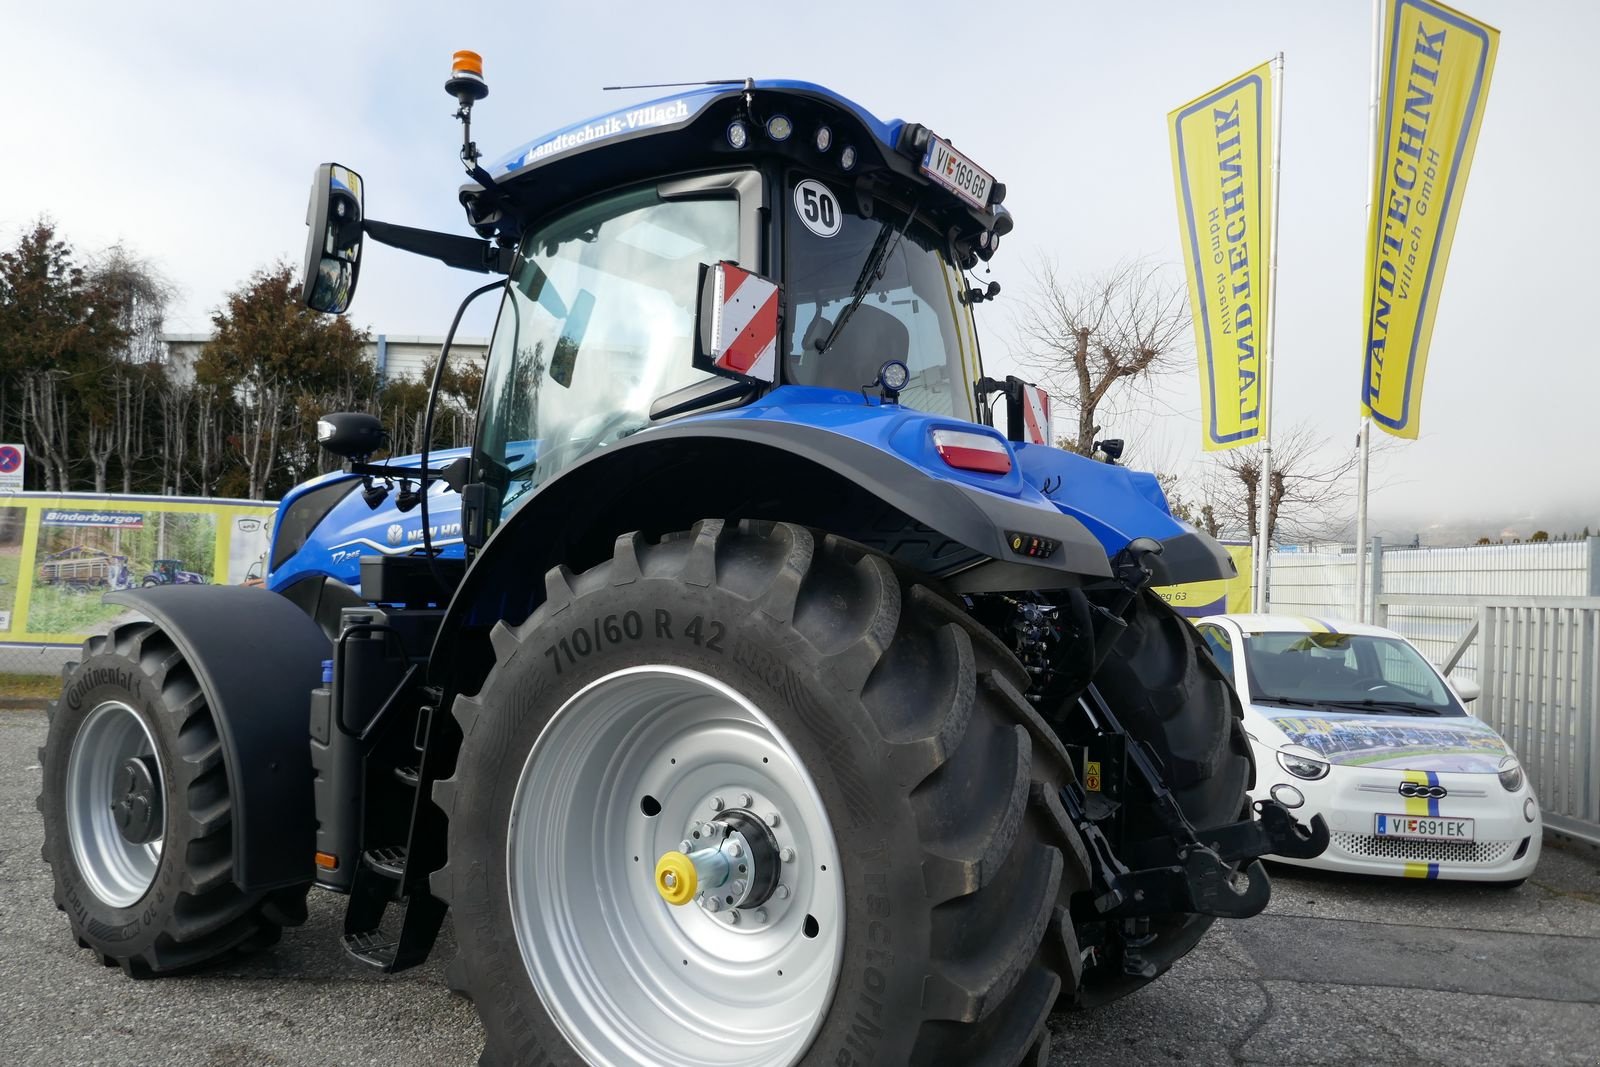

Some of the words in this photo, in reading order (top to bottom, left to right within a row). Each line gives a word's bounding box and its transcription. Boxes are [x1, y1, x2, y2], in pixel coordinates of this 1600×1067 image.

[528, 100, 688, 160] Landtechnik-Villach
[936, 147, 949, 174] VI
[802, 187, 834, 228] 50
[1368, 21, 1446, 403] LANDTECHNIK
[1398, 226, 1422, 299] Villach
[1416, 148, 1439, 216] GmbH
[46, 512, 140, 524] Binderberger
[1159, 590, 1172, 602] eg
[1175, 592, 1187, 601] 63
[544, 609, 643, 675] 710/60
[655, 609, 673, 639] R
[684, 615, 727, 653] 42
[67, 667, 133, 711] Continental
[1399, 781, 1447, 799] 500
[1393, 819, 1406, 833] VI
